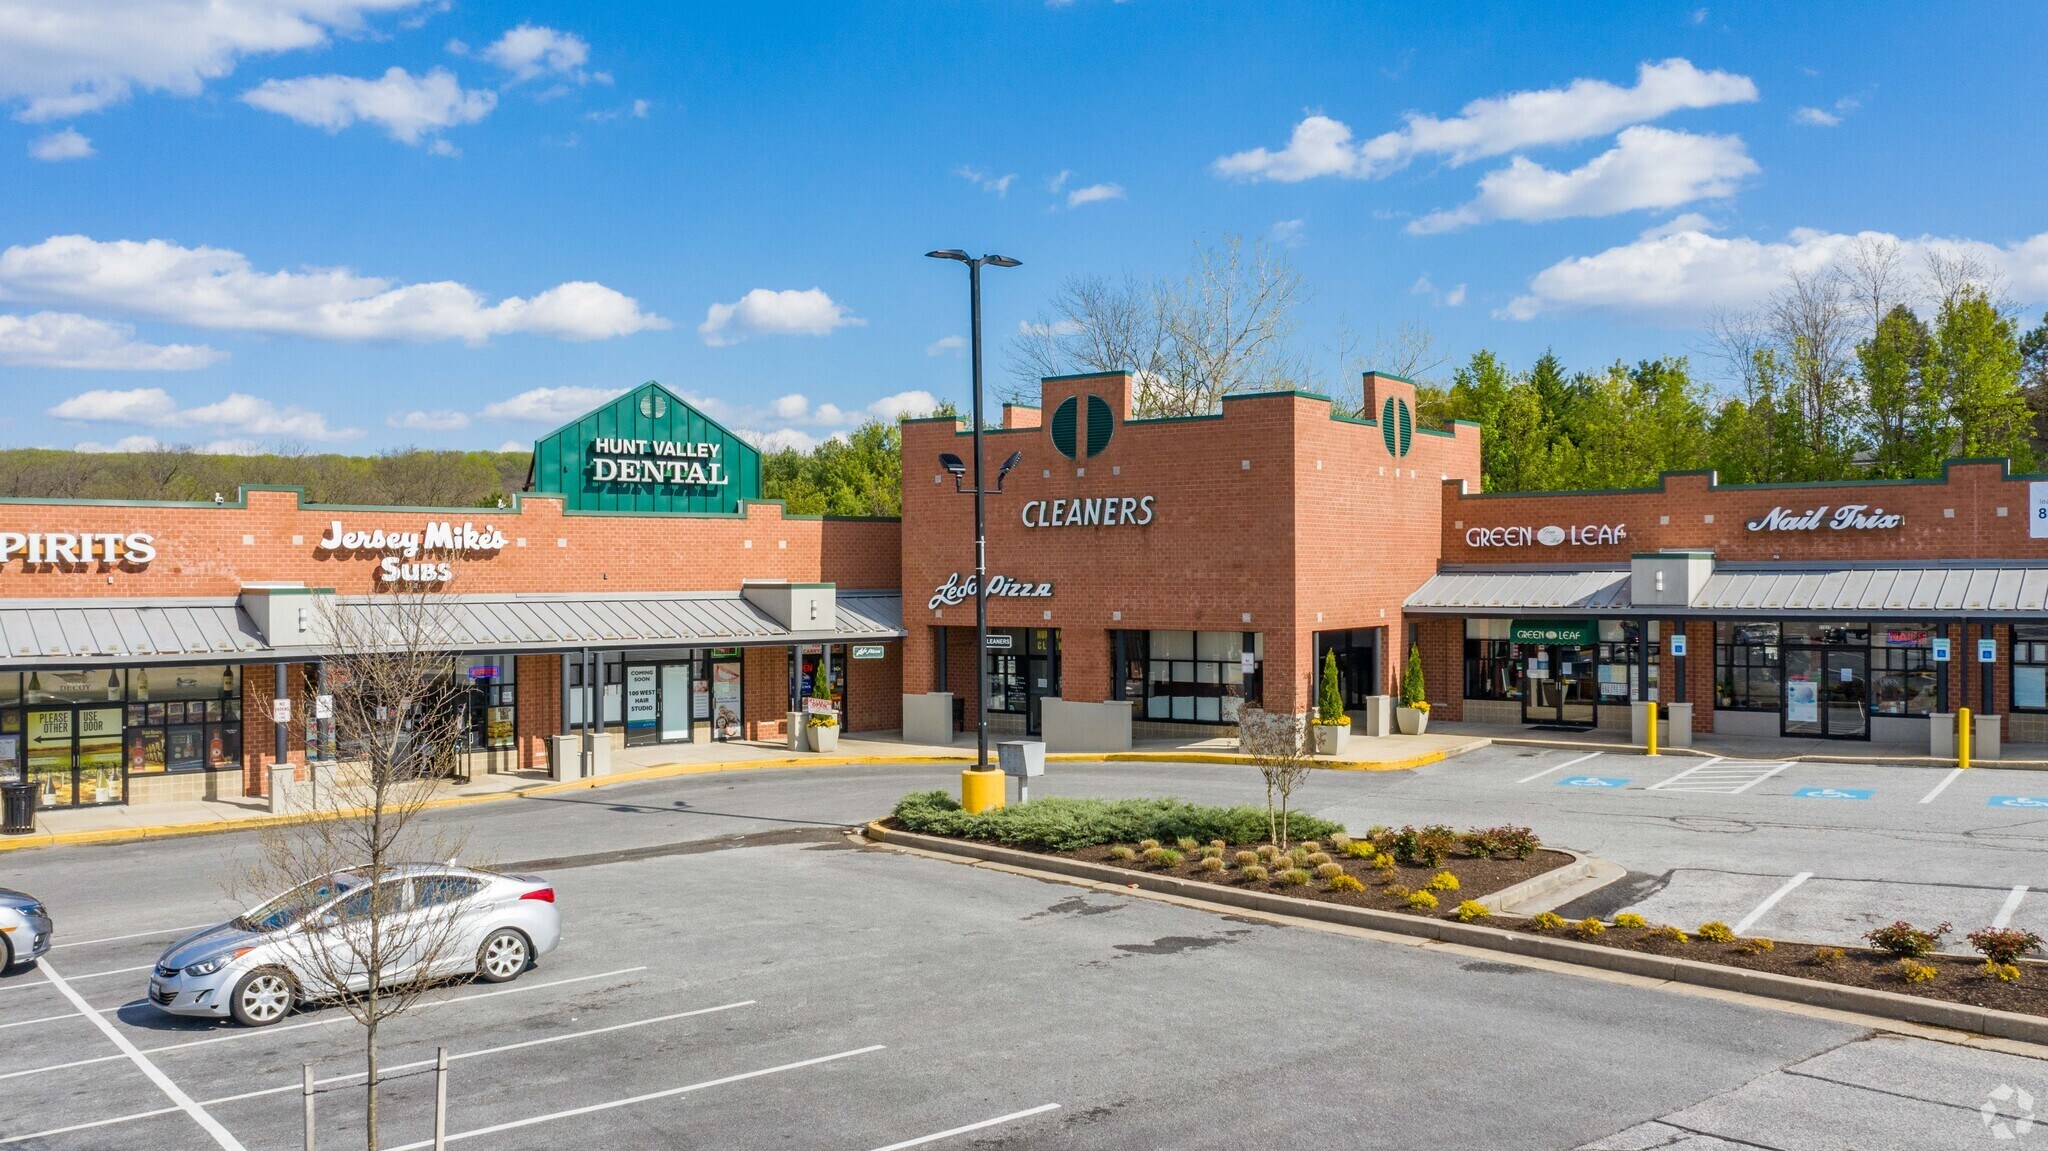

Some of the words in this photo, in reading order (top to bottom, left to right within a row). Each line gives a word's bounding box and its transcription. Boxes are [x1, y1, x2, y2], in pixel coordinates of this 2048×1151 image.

[596, 438, 648, 455] HUNT
[652, 440, 720, 458] VALLEY
[592, 458, 729, 485] DENTAL
[1021, 495, 1154, 528] CLEANERS
[1748, 506, 1829, 531] Nail
[1829, 504, 1900, 530] Trix
[320, 520, 420, 557] Jersey
[424, 521, 508, 550] Mike's
[1466, 526, 1532, 547] GREEN
[1571, 523, 1627, 546] LEAF
[928, 572, 978, 609] Ledo
[1517, 630, 1545, 639] GREEN
[1558, 630, 1581, 640] LEAF
[60, 684, 91, 692] DECOY
[40, 713, 68, 724] PLEASE
[83, 711, 98, 721] USE
[43, 723, 68, 733] OTHER
[83, 721, 103, 732] DOOR
